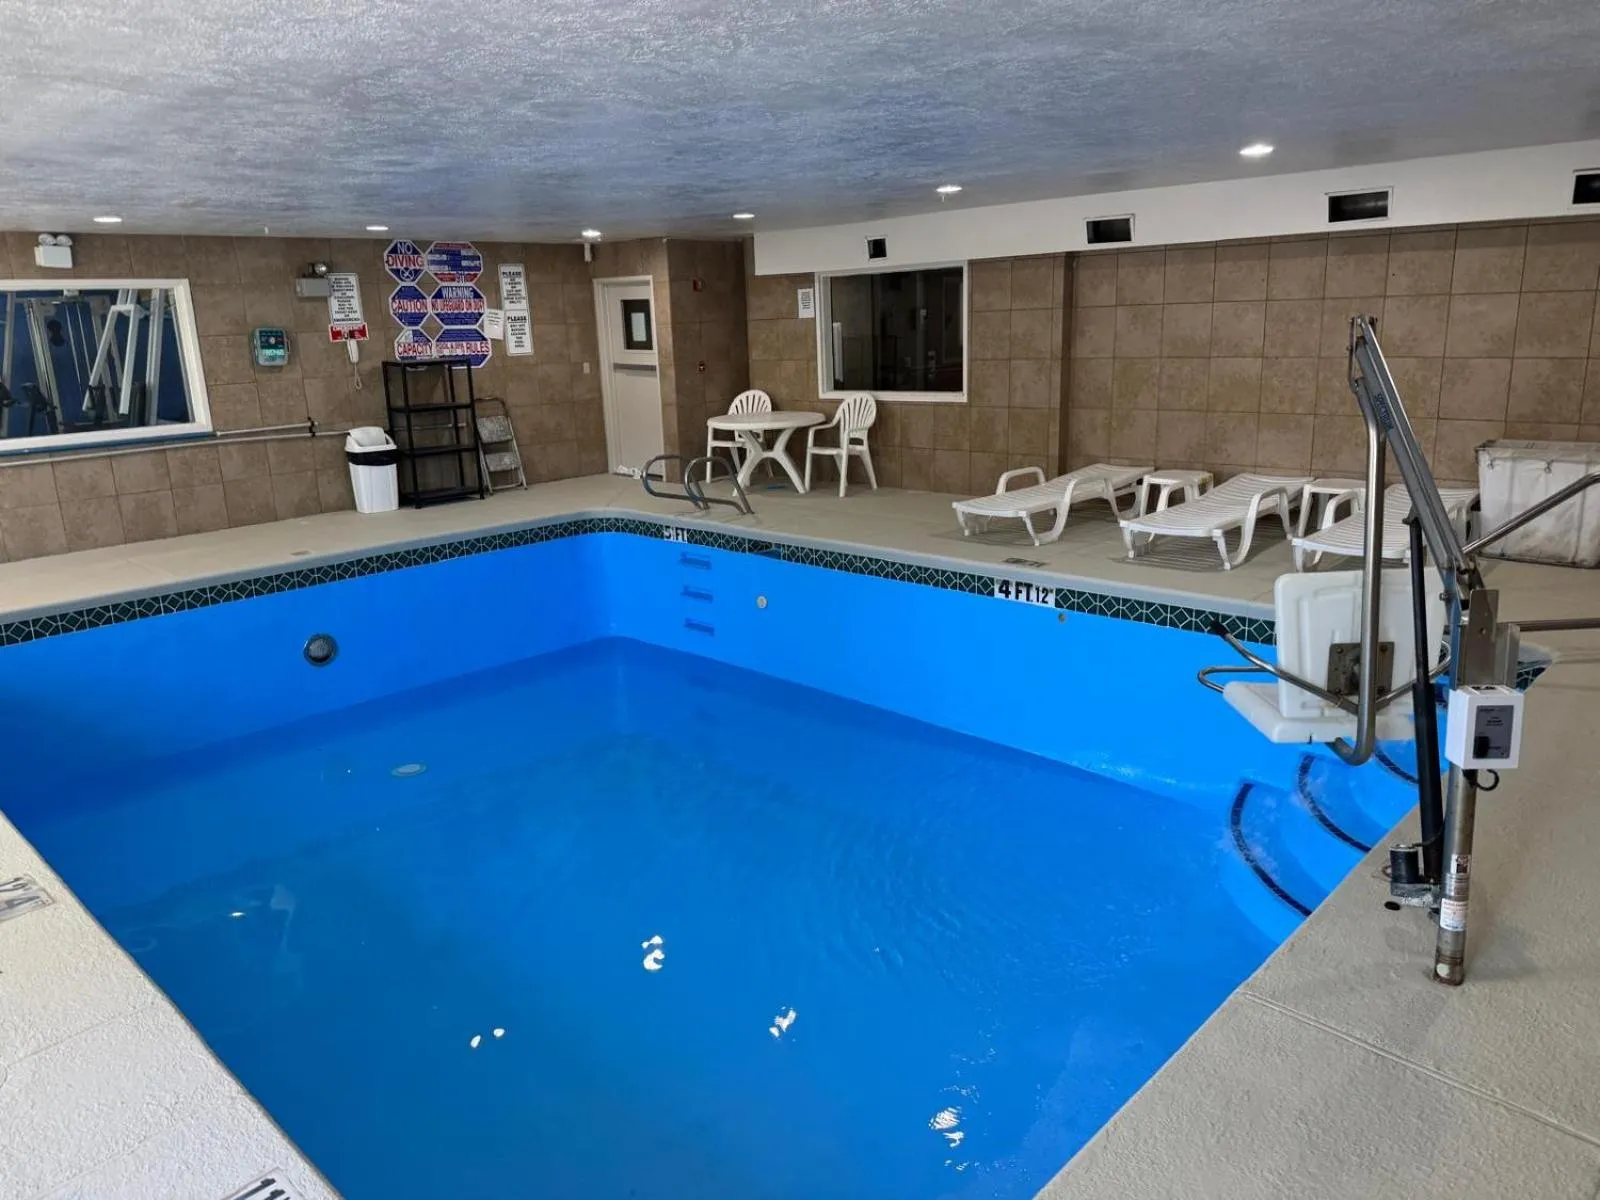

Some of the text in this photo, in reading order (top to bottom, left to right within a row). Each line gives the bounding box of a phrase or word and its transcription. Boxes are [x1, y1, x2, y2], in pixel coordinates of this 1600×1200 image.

[397, 241, 412, 254] NO
[387, 255, 425, 268] DIVING
[441, 286, 475, 299] WARNING
[391, 300, 427, 312] CAUTION
[397, 343, 433, 355] CAPACITY
[466, 341, 490, 353] RULES
[998, 579, 1012, 599] 4
